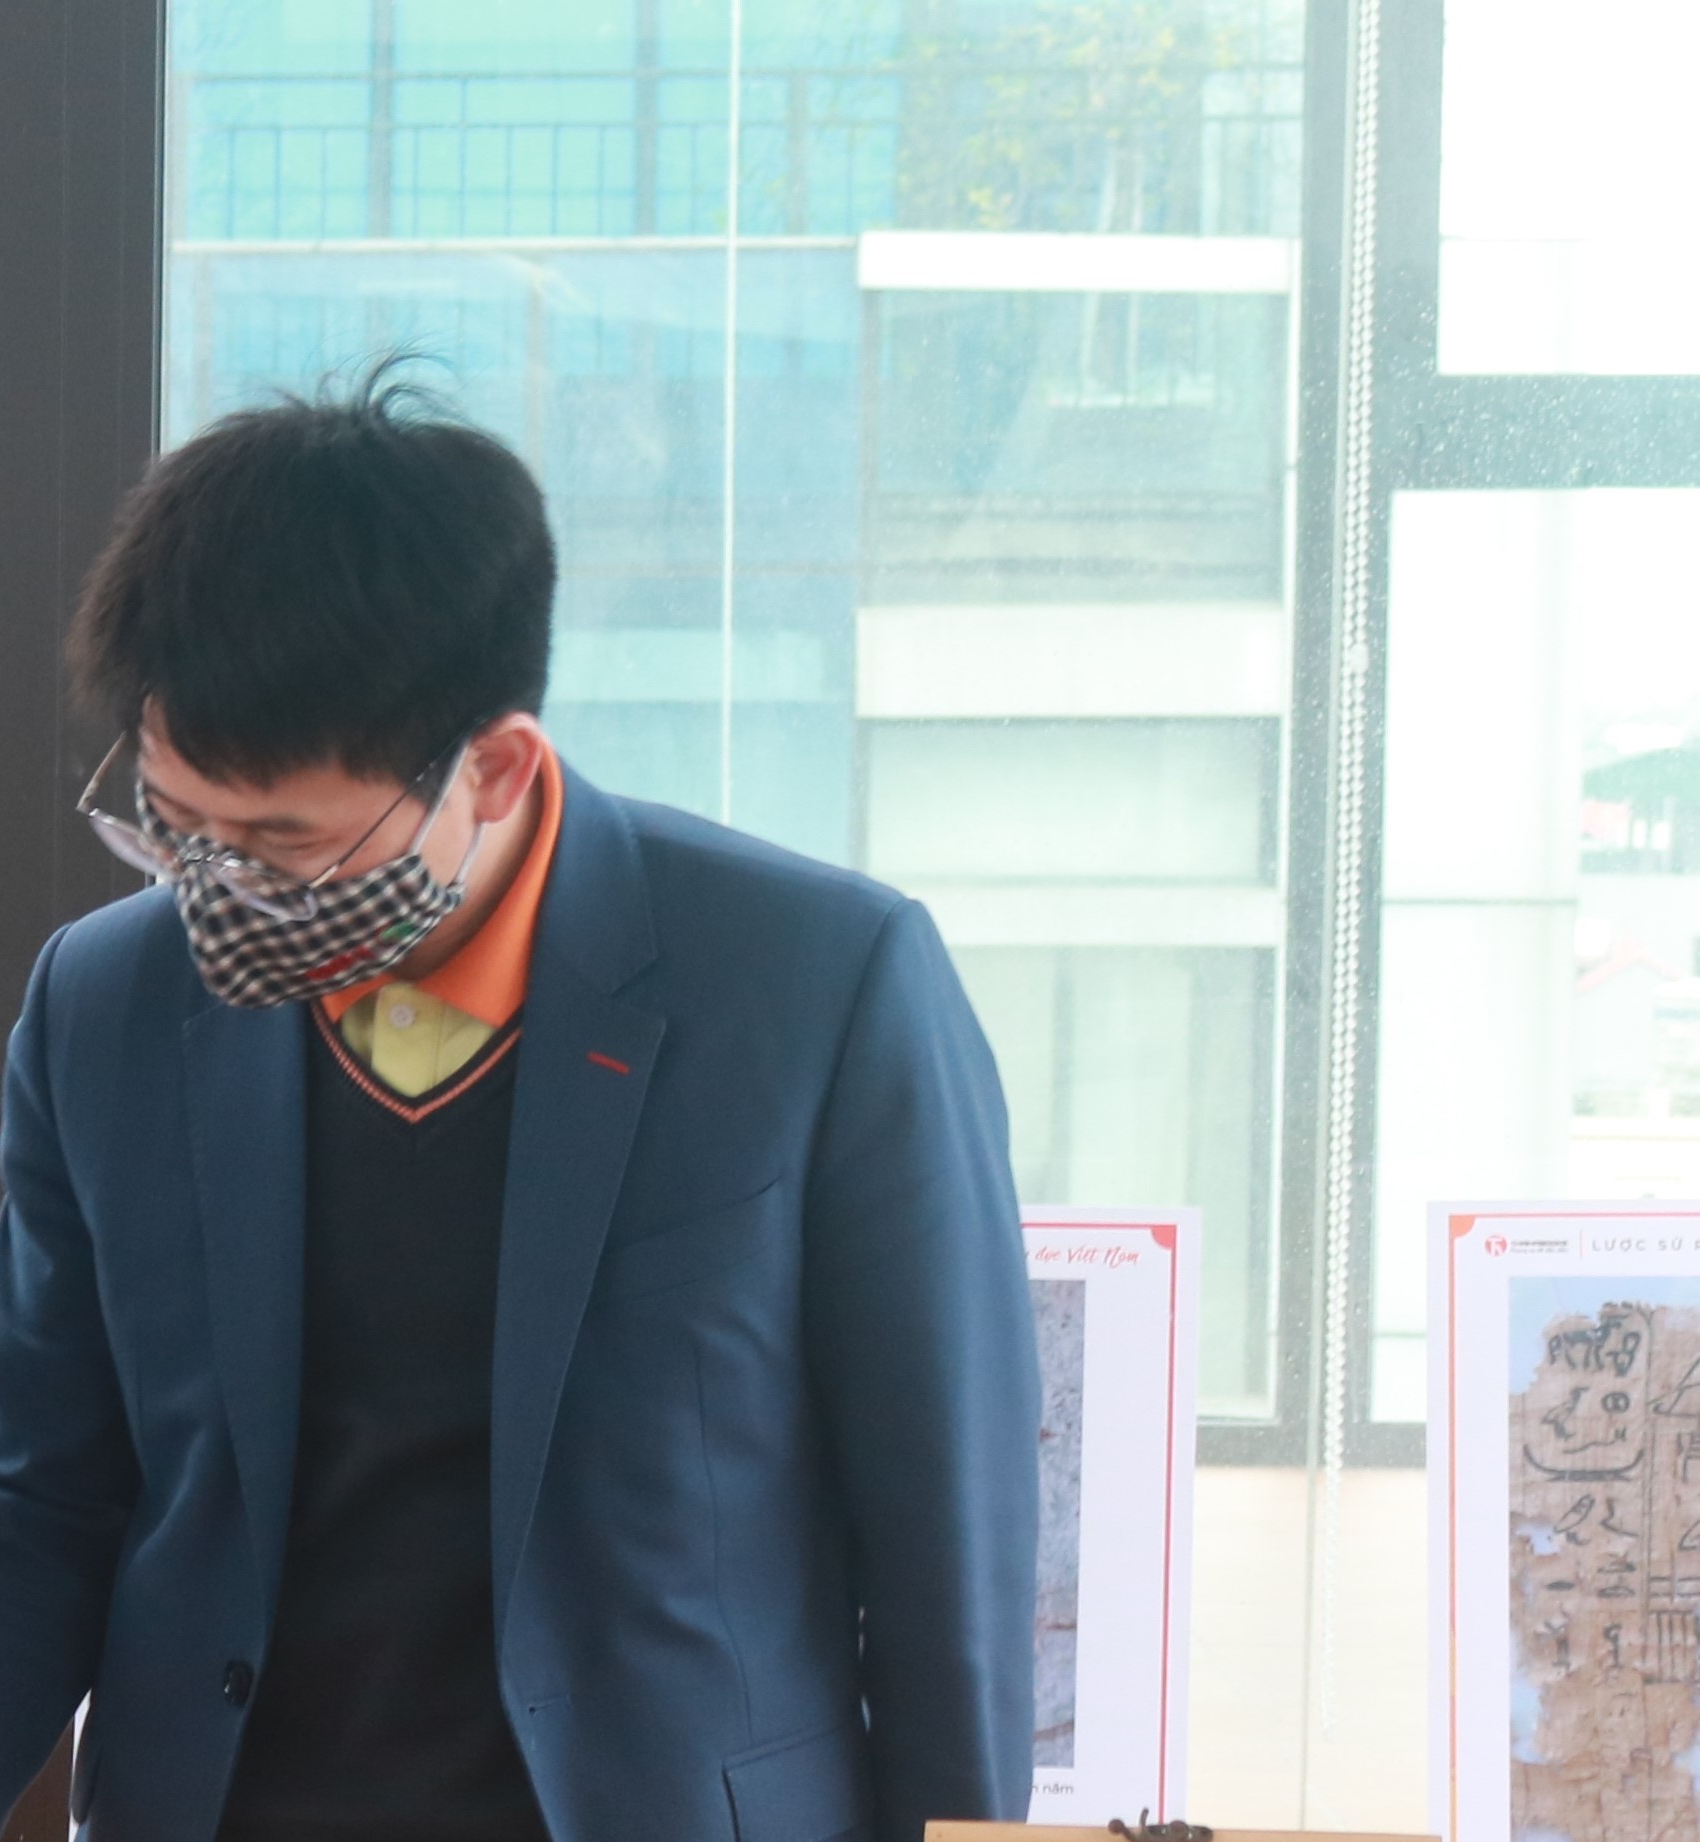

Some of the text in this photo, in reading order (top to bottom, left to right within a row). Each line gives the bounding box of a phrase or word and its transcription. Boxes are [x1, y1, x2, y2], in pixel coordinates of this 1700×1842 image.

[1591, 1236, 1646, 1253] LƯỢC
[1067, 1244, 1098, 1265] Việt
[1104, 1245, 1140, 1269] Nam
[1043, 1782, 1074, 1795] năm
